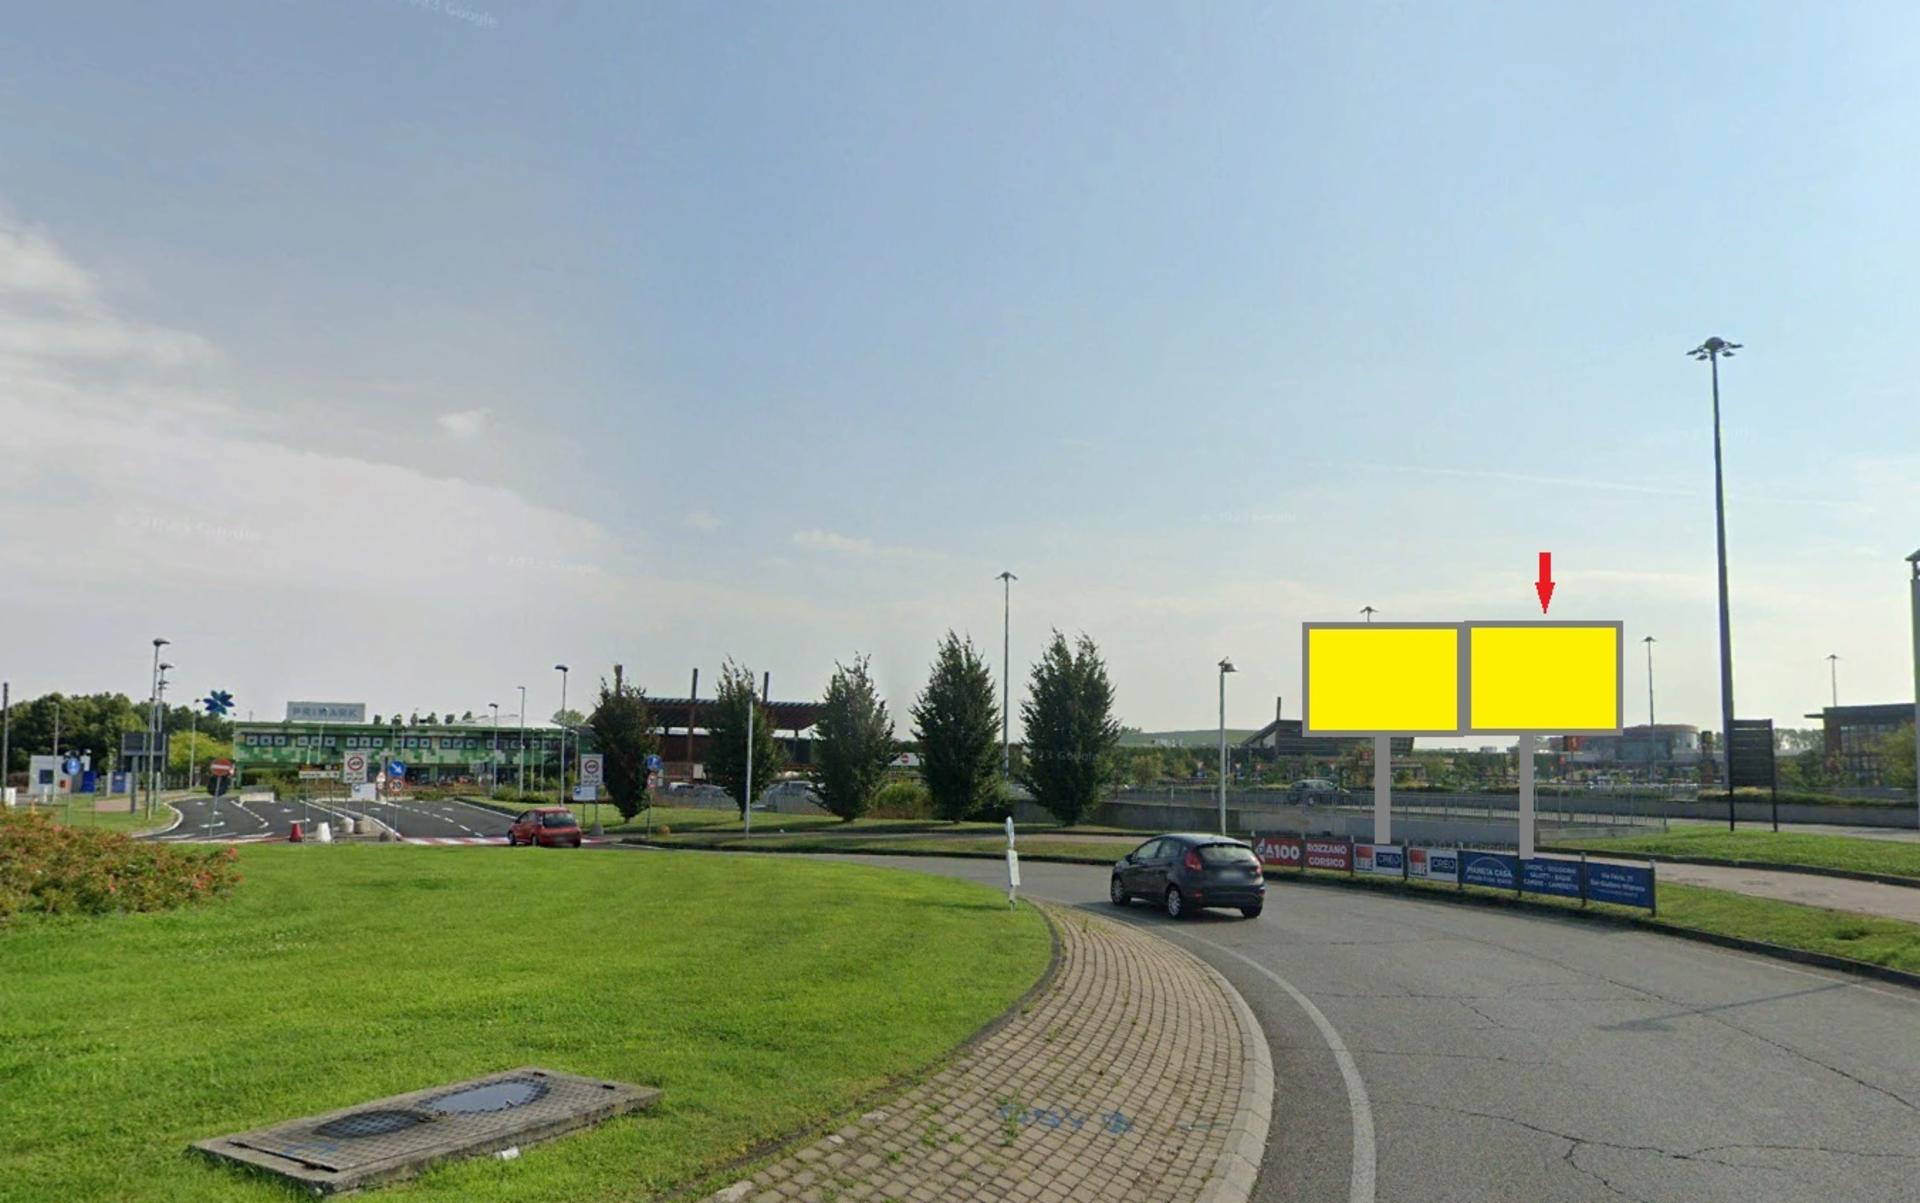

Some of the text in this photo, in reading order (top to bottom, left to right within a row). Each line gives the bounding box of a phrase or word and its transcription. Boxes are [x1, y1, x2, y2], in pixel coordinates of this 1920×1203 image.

[292, 706, 358, 718] PRIMARK
[1306, 843, 1347, 855] ROZZANO
[1308, 855, 1345, 868] CORSICO
[1431, 858, 1455, 869] CREO
